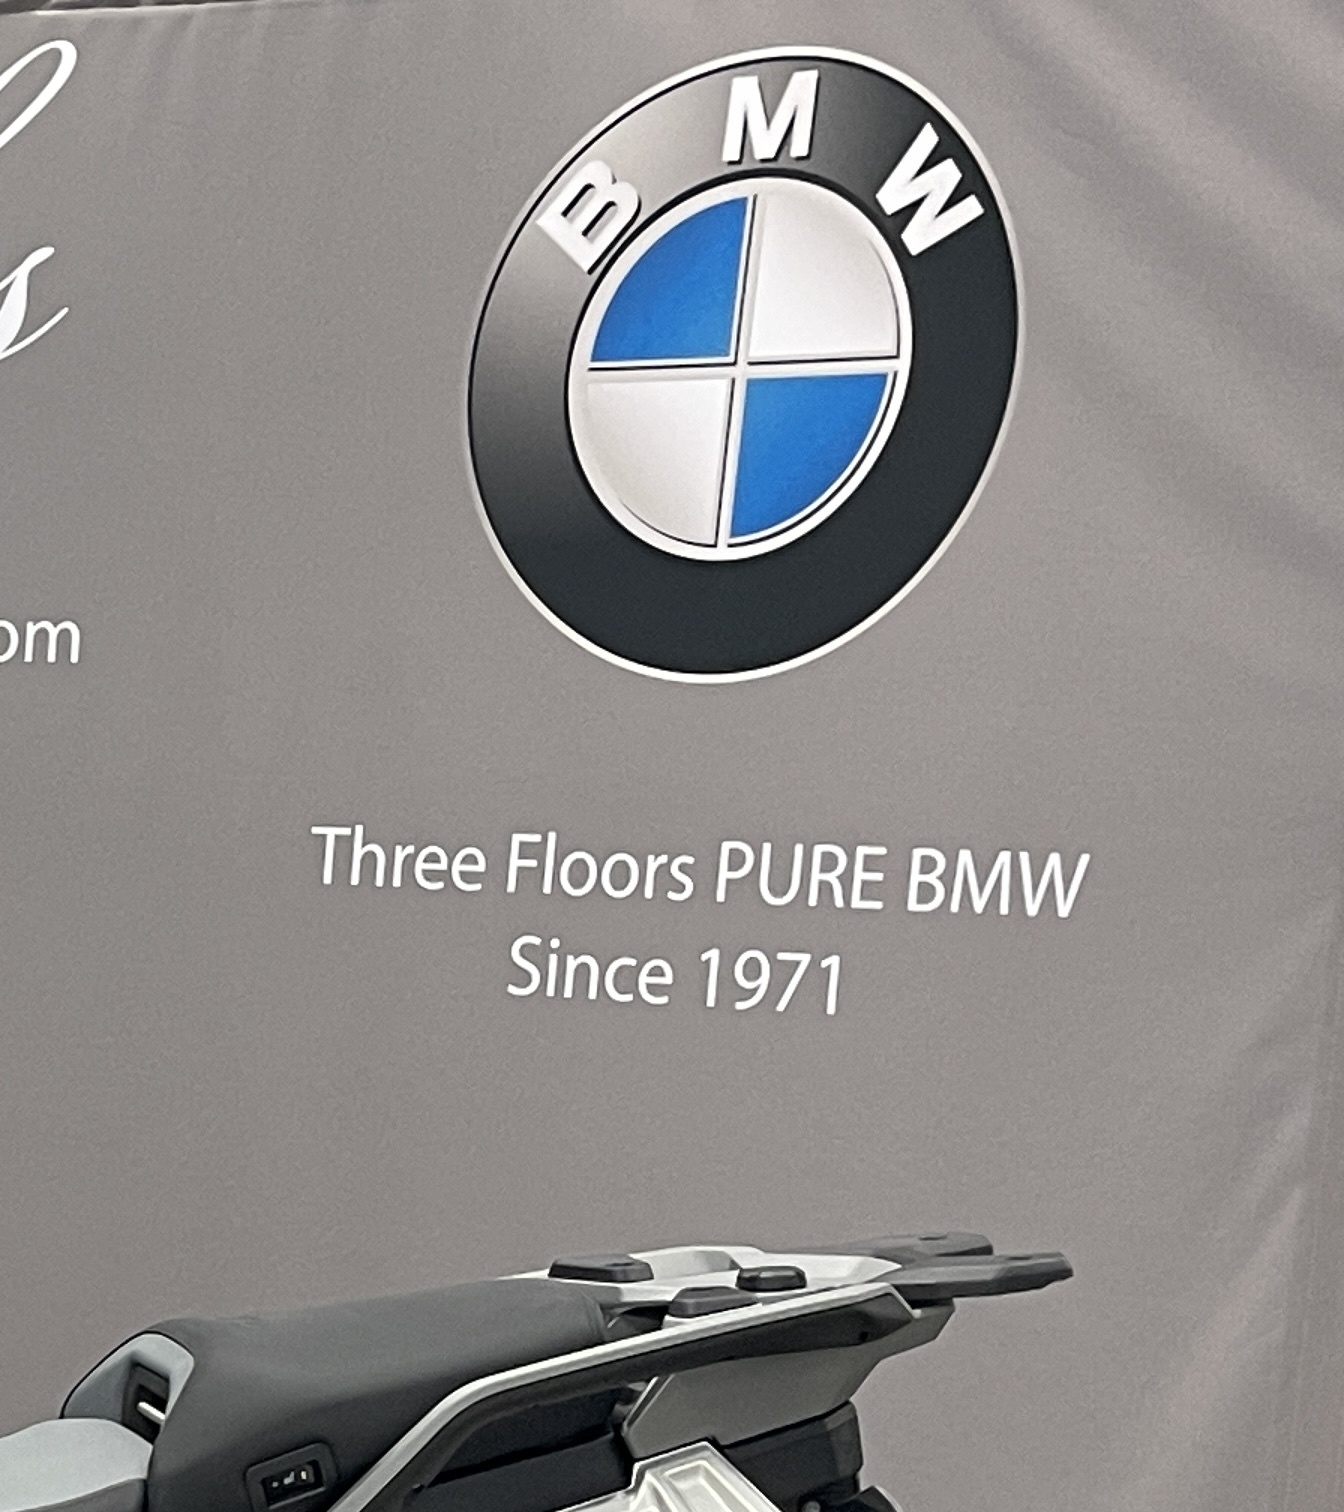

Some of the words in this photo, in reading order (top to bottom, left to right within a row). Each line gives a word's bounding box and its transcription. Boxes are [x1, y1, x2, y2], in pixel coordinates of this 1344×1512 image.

[537, 70, 984, 274] BMW
[310, 824, 487, 892] Three
[506, 831, 695, 901] Floors
[716, 840, 888, 910] PURE
[907, 847, 1091, 918] BMW
[506, 935, 674, 1005] Since
[700, 947, 841, 1016] 1971
